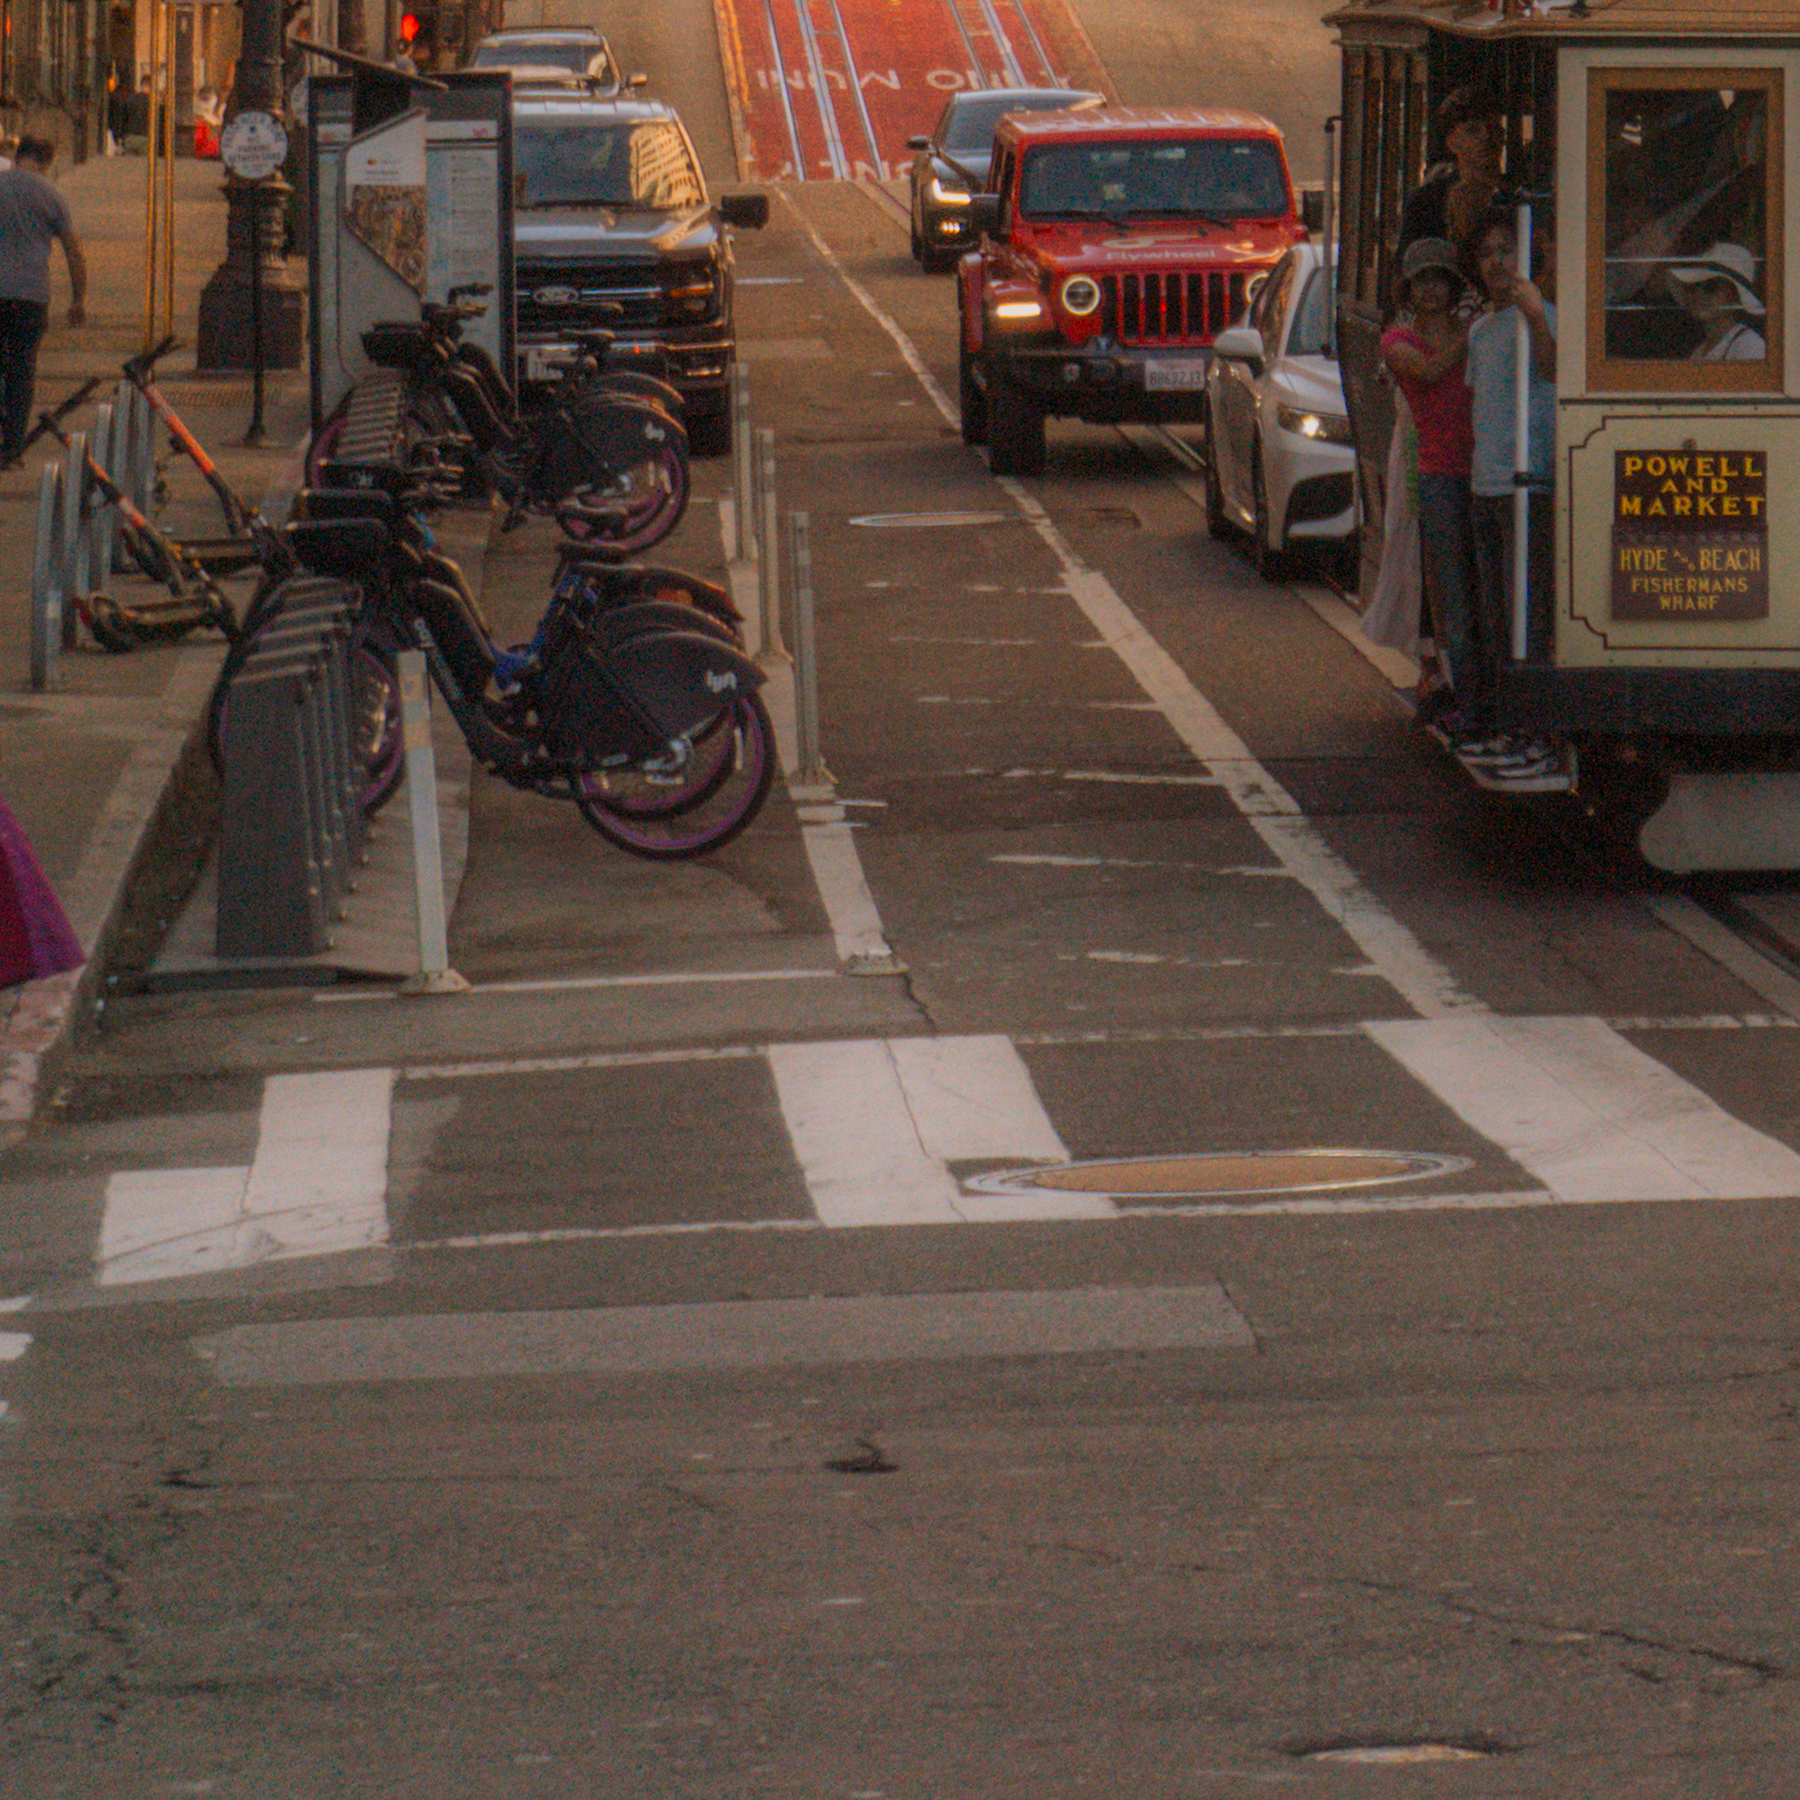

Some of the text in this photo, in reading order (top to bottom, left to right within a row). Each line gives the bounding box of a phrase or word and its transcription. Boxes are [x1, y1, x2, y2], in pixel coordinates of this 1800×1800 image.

[1107, 250, 1216, 262] Flywheel
[1625, 456, 1762, 477] POWELL
[1661, 478, 1729, 494] AND
[1620, 495, 1765, 516] MARKET
[1620, 548, 1668, 572] HYDE
[1699, 548, 1762, 572] BEACH
[1631, 576, 1749, 593] FISHERMANS
[1660, 595, 1720, 611] WHARF
